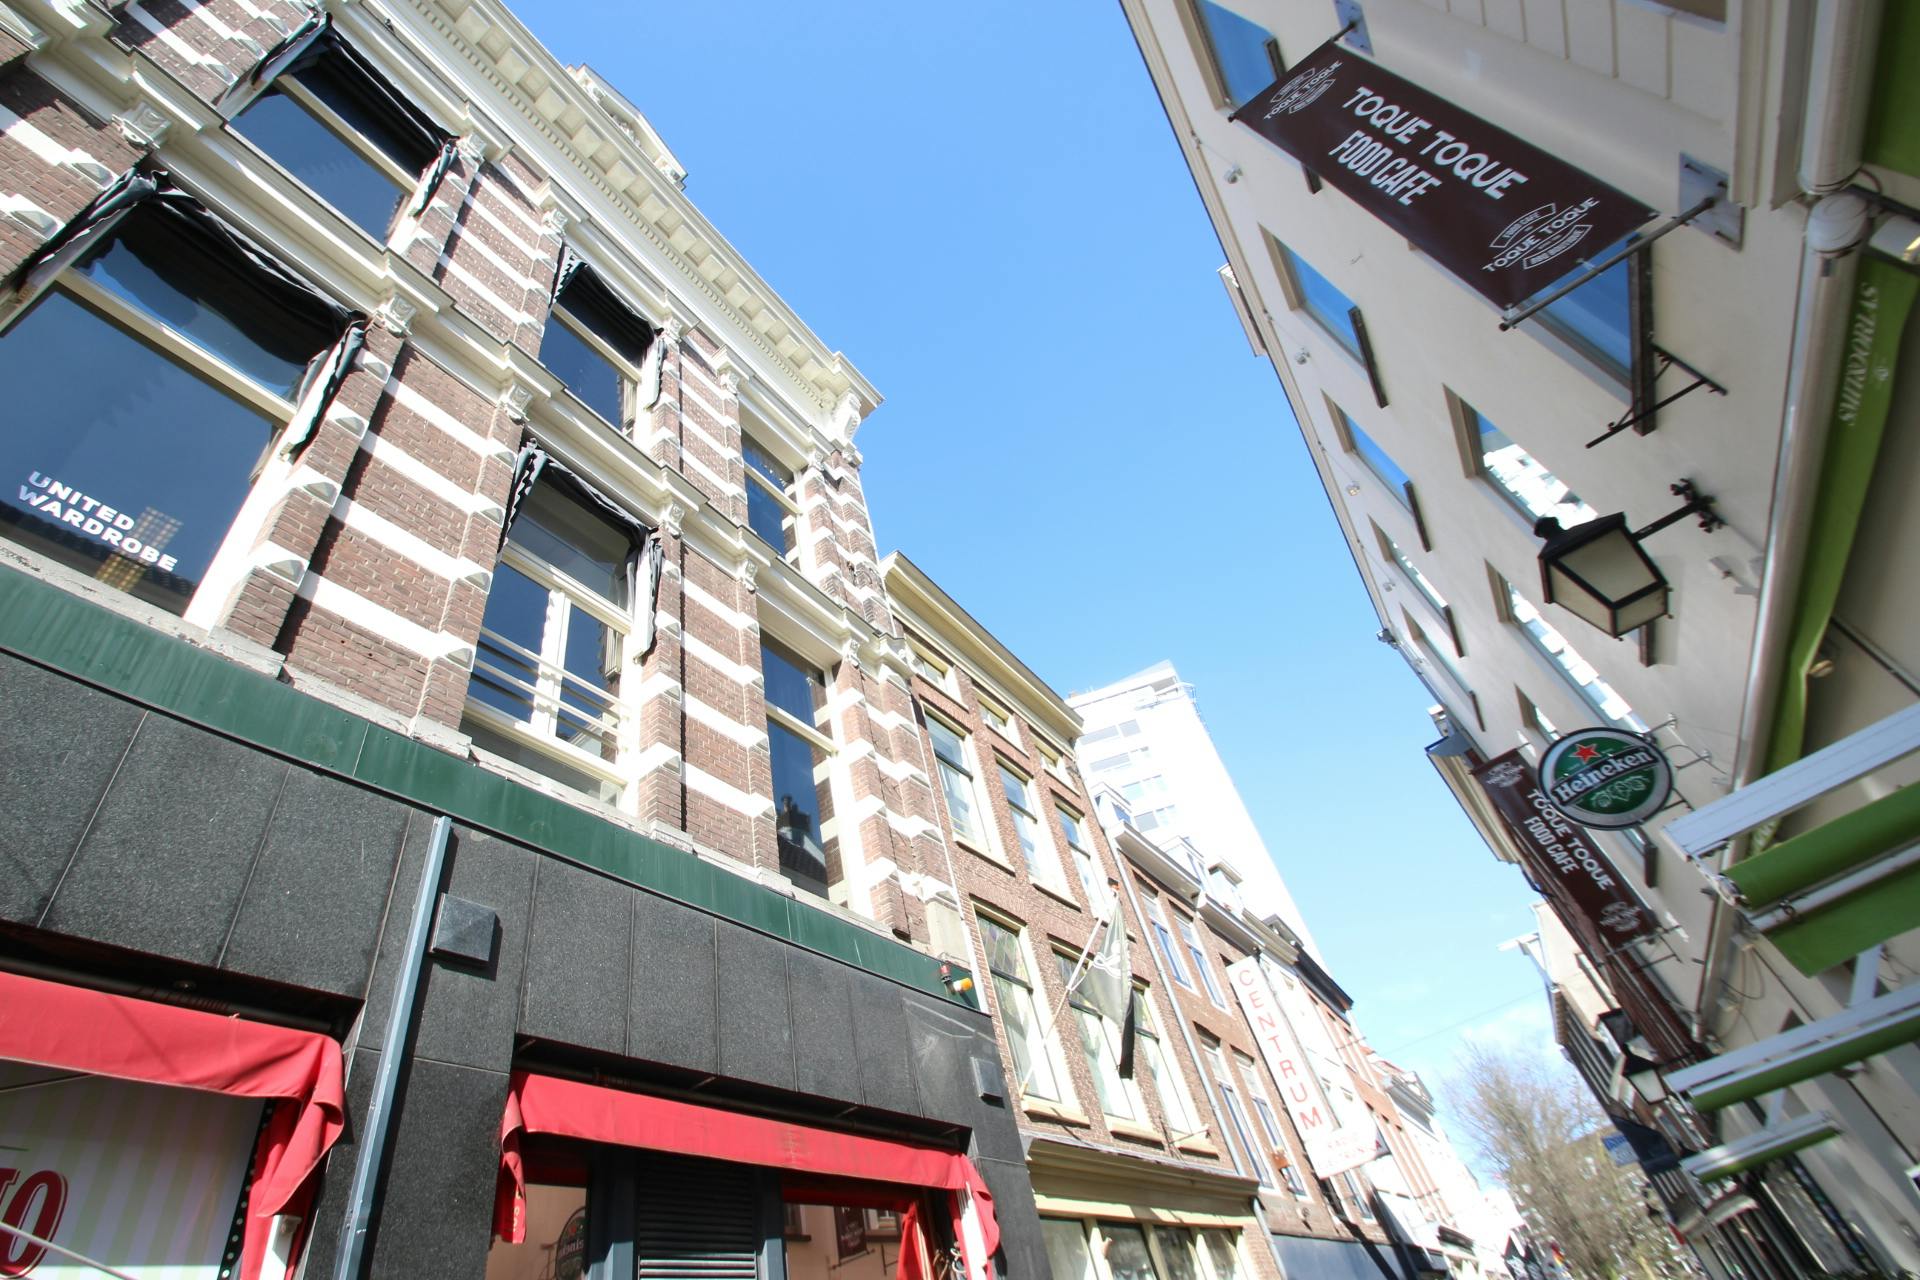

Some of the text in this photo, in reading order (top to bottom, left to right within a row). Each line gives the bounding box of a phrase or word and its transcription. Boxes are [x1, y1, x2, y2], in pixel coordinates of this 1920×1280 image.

[1328, 130, 1442, 206] FOOD CAFE
[1342, 86, 1432, 145] TOQUE
[1419, 131, 1529, 200] TOQUE
[1481, 234, 1541, 272] TOQUE
[1539, 197, 1600, 234] TOQUE
[18, 485, 178, 572] WARDROBE
[28, 471, 135, 531] UNITED
[1554, 749, 1653, 802] Heineken
[1523, 816, 1580, 874] FOOD CAFE
[1527, 789, 1616, 890] TOQUE TOQUE
[1238, 969, 1323, 1131] CENTRUM
